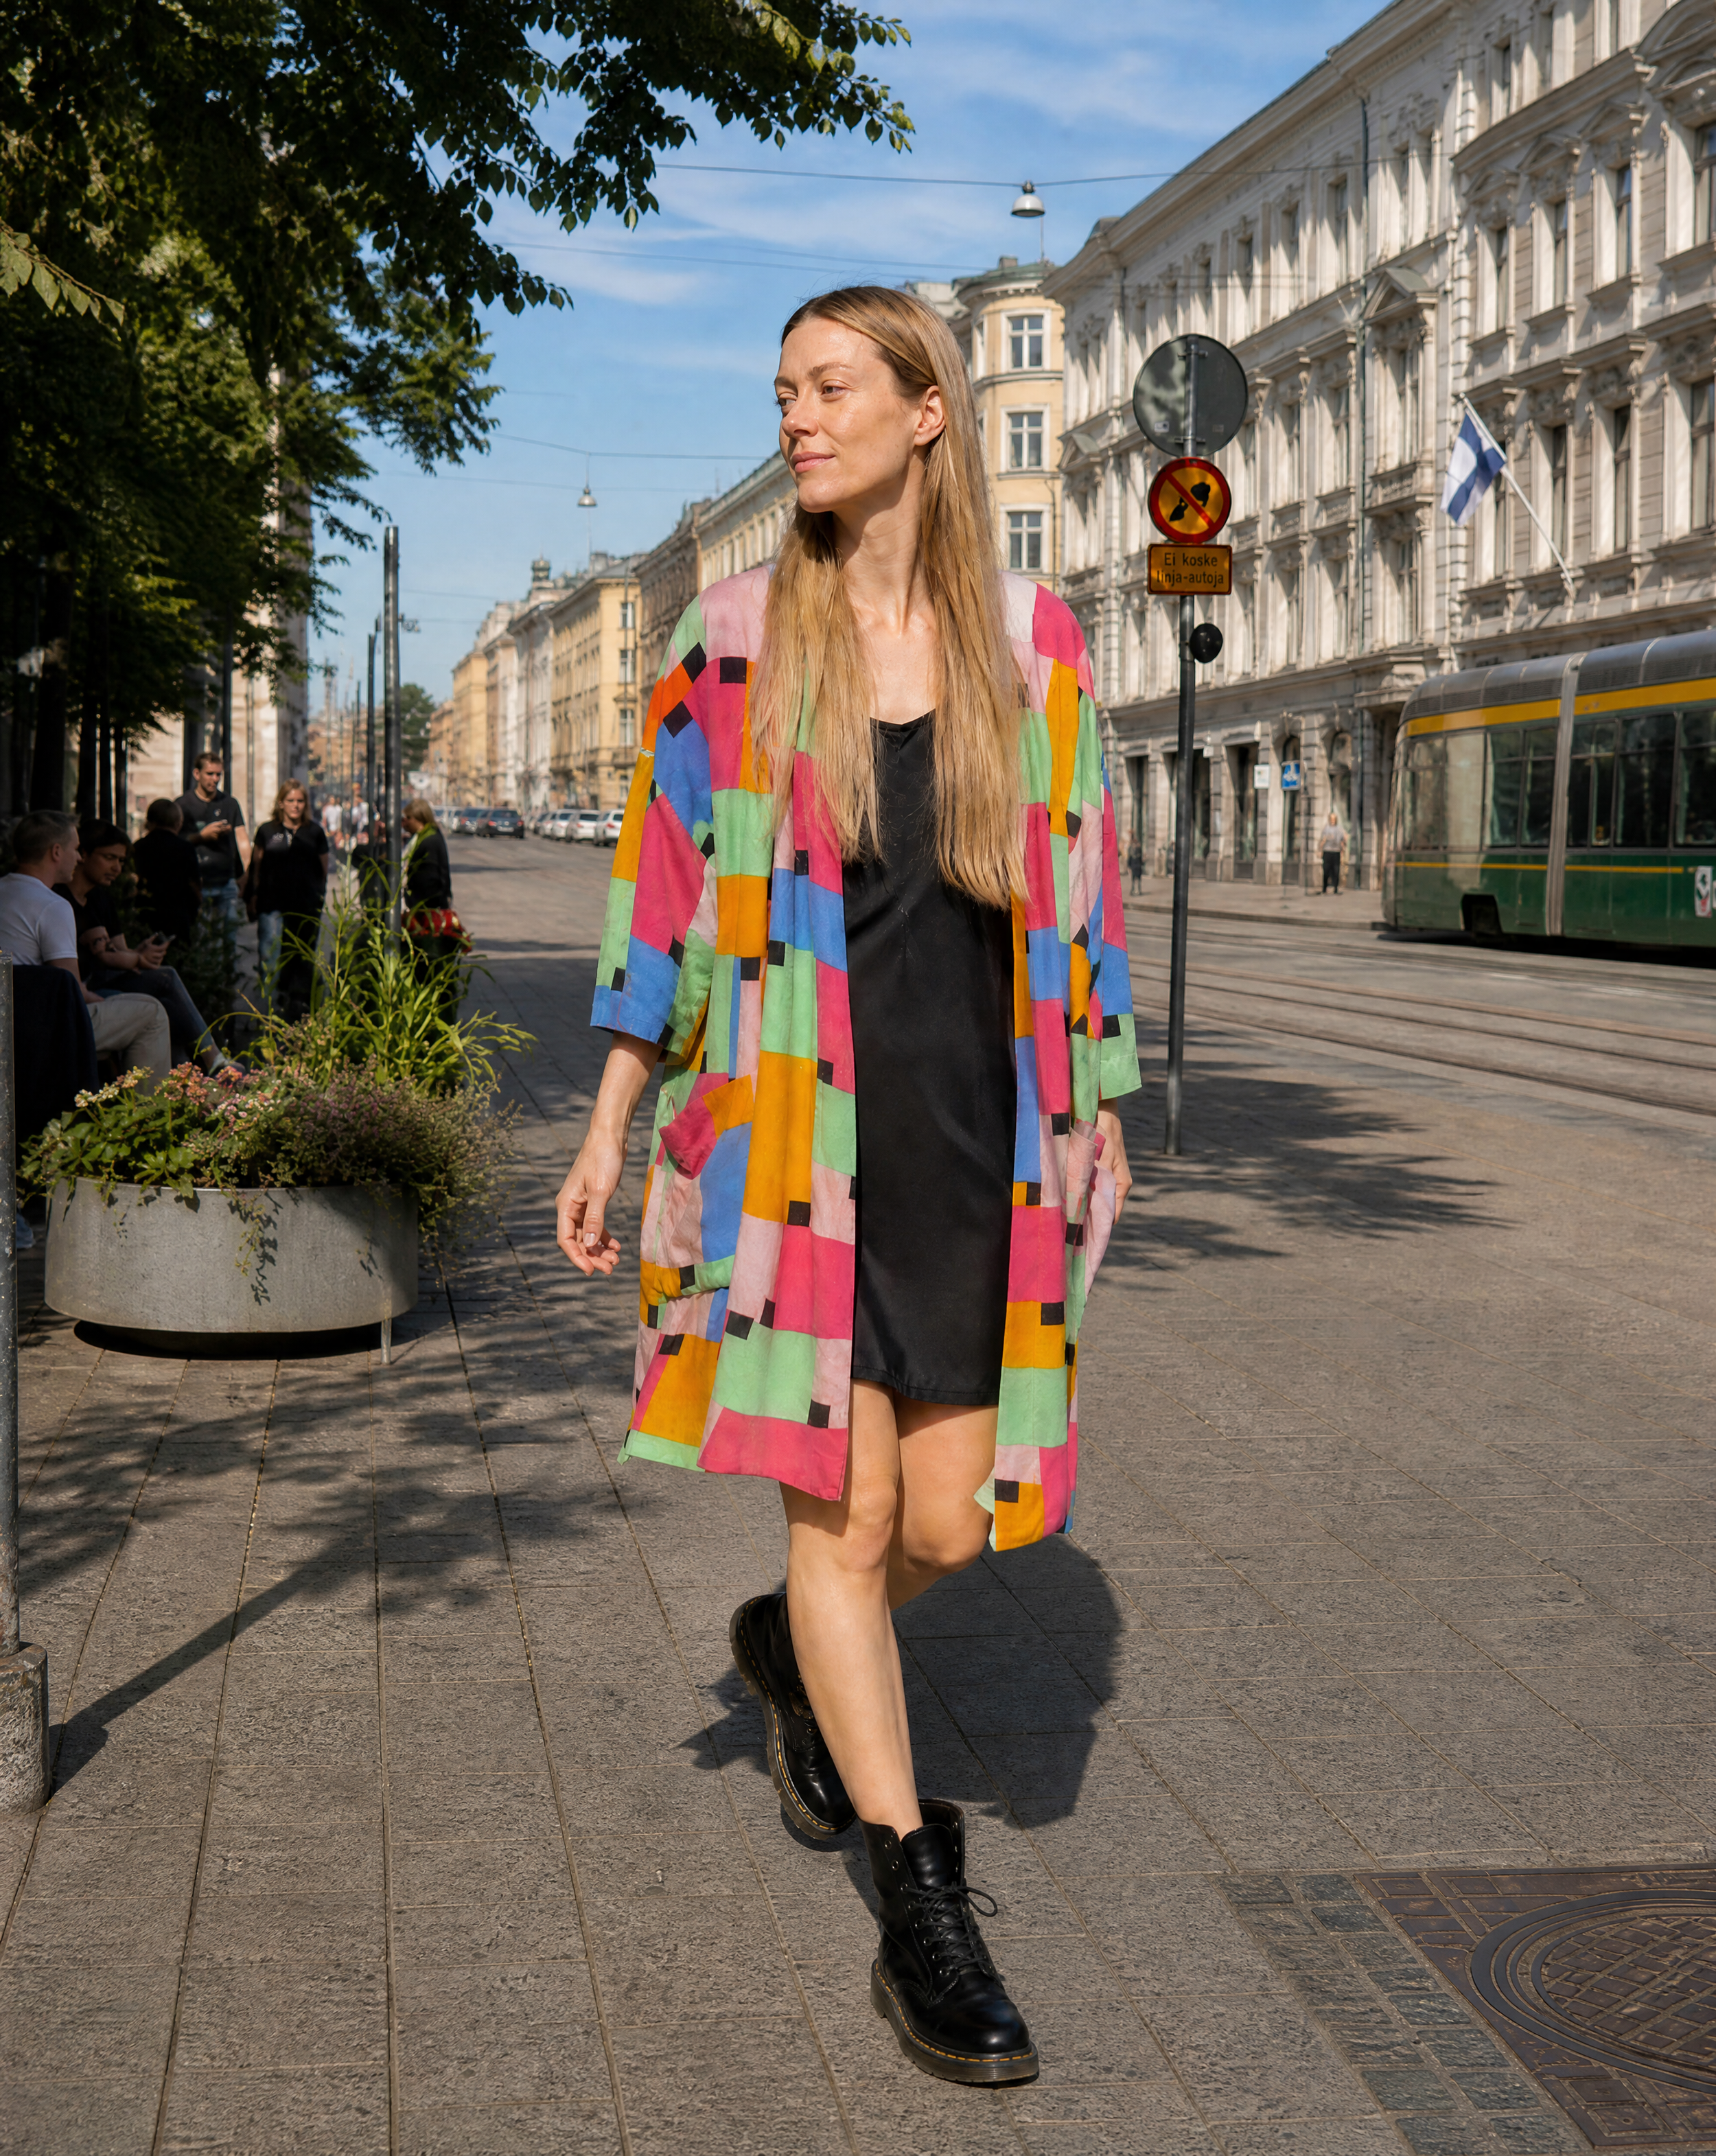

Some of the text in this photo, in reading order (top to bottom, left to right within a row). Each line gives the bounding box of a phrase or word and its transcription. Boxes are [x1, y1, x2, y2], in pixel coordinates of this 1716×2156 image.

[1164, 553, 1218, 566] Ei koske
[1157, 570, 1224, 588] linja-autoja
